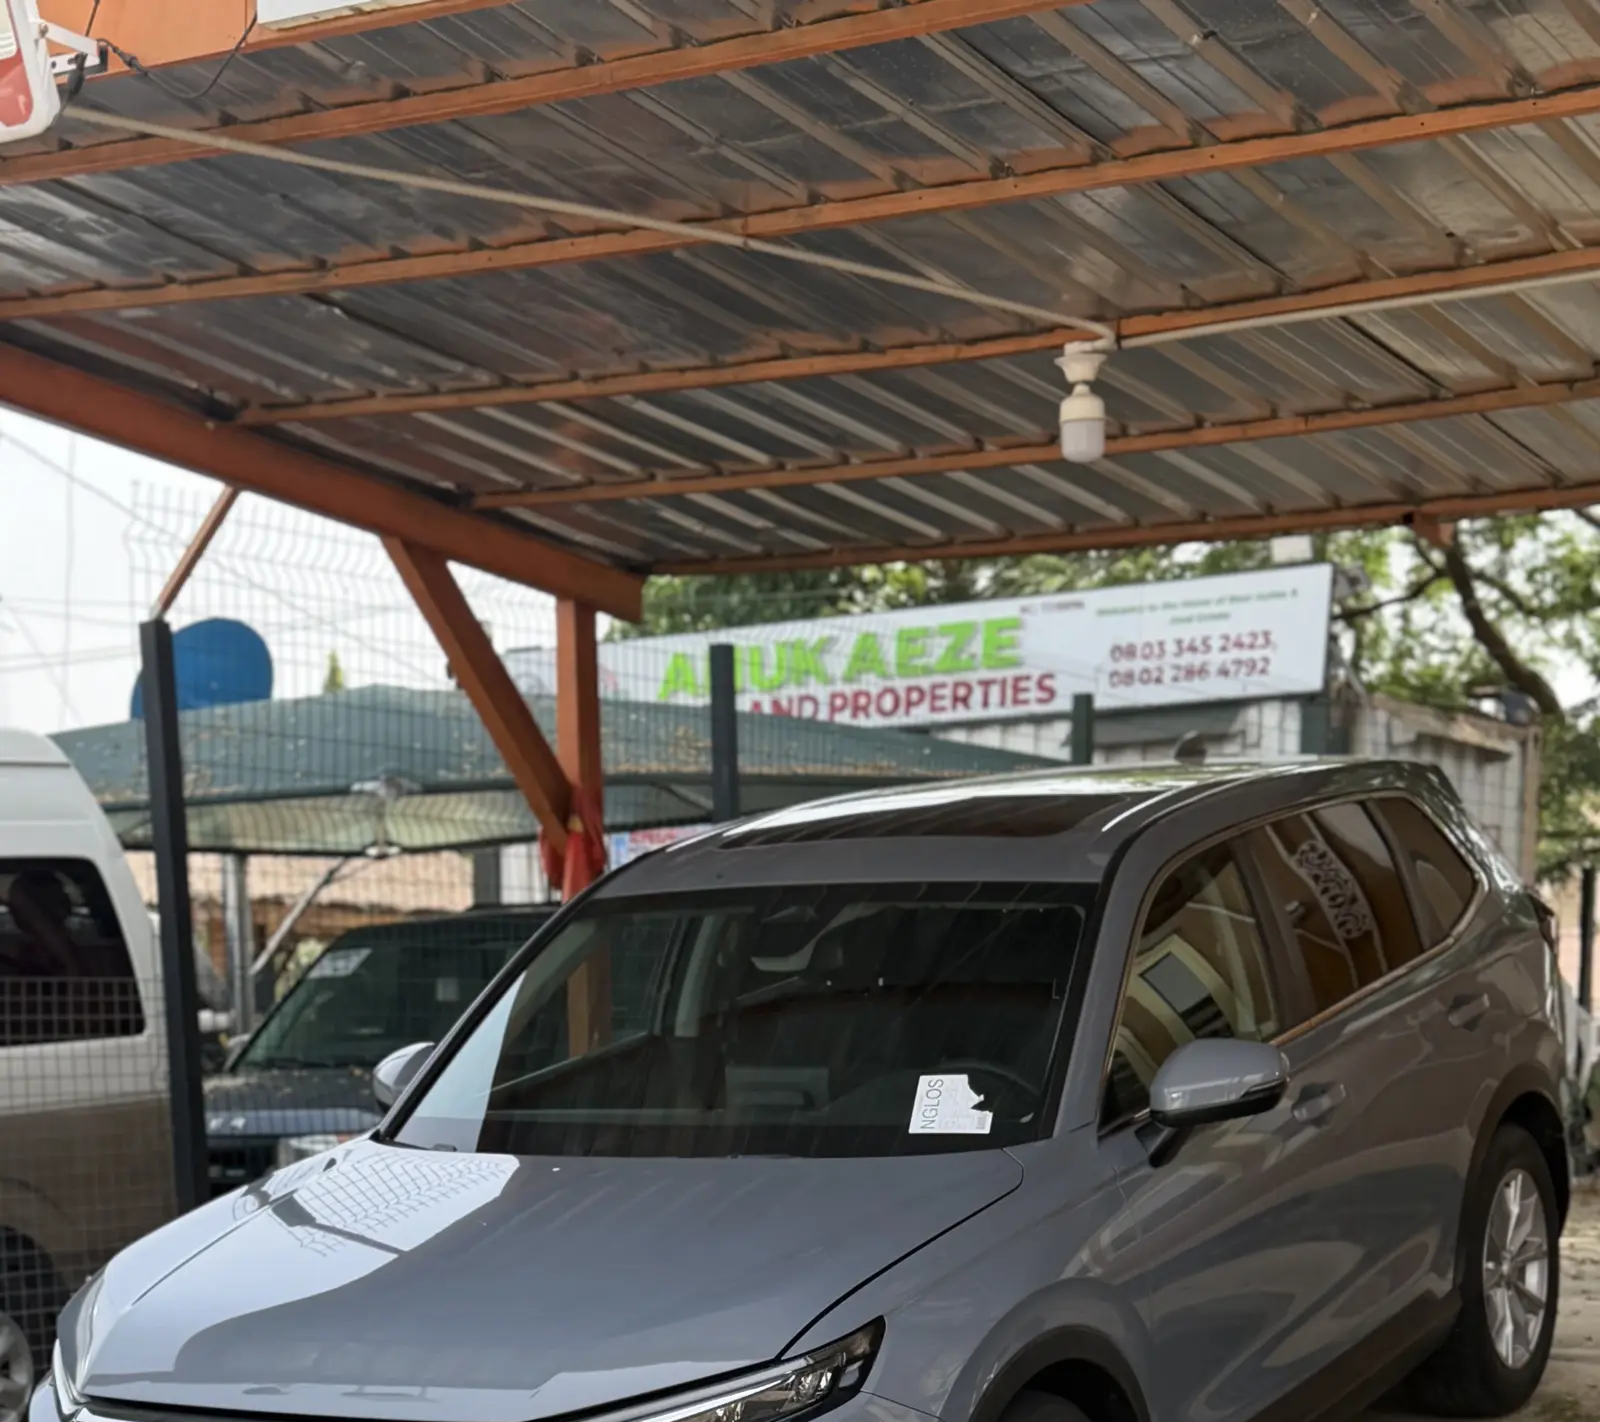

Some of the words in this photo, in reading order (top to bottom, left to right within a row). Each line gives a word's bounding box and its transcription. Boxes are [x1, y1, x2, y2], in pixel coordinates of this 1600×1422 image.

[1172, 635, 1213, 658] 345
[827, 673, 1057, 722] PROPERTIES
[920, 1078, 944, 1129] NGLOS
